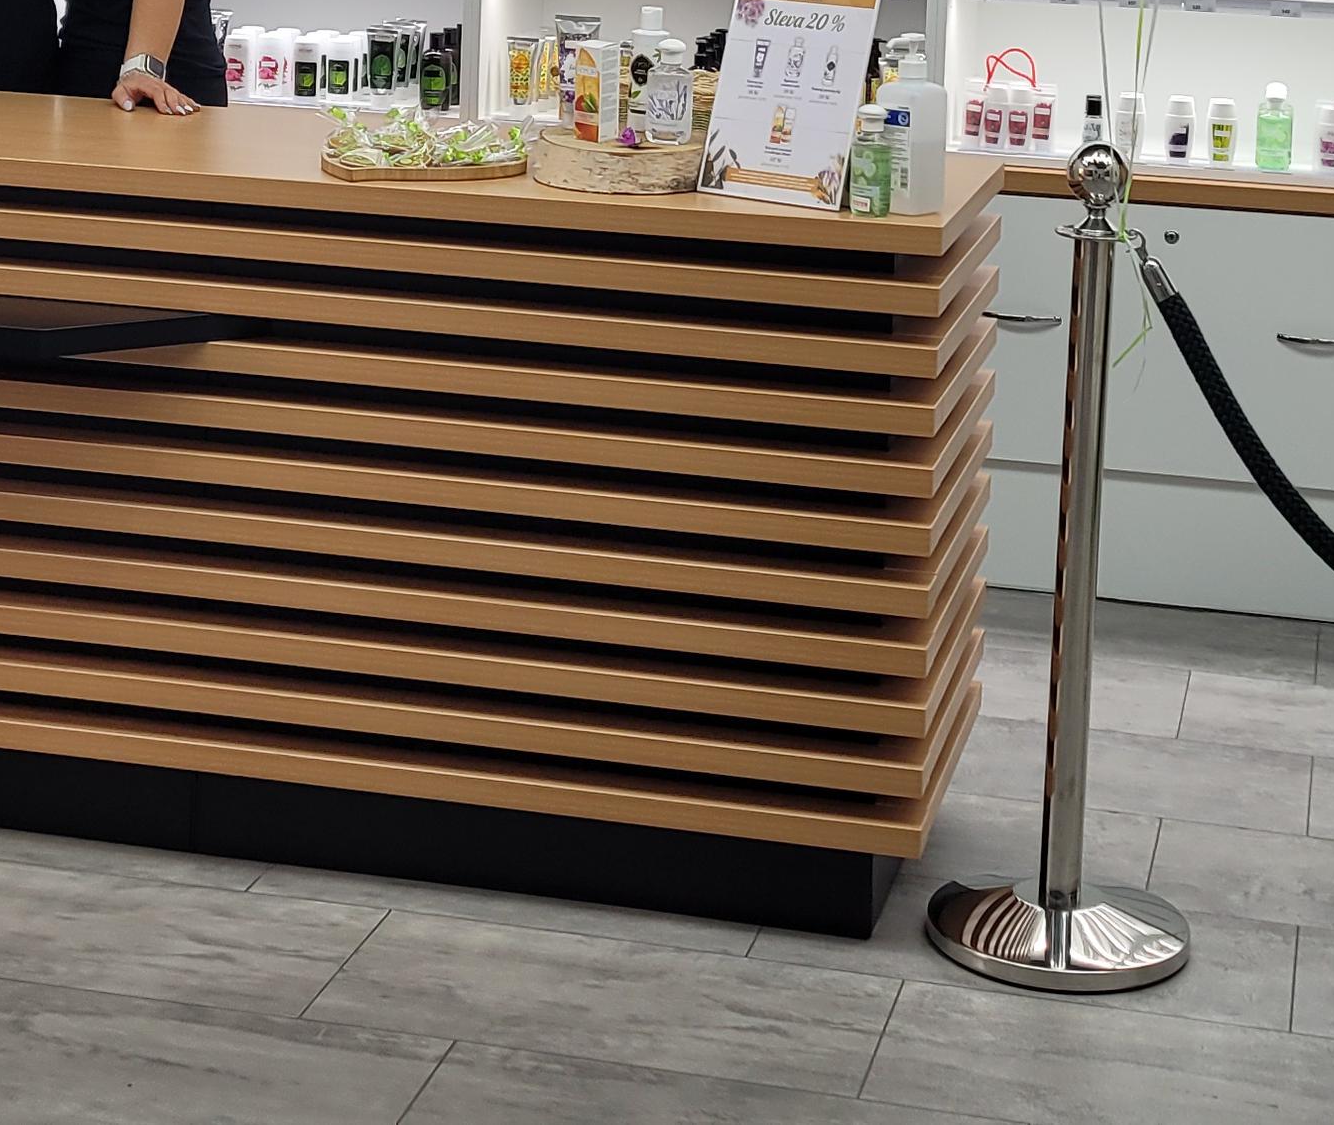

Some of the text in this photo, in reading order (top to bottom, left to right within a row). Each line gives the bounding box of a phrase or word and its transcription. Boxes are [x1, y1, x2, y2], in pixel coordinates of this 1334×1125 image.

[764, 8, 845, 33] Sleva 20 %
